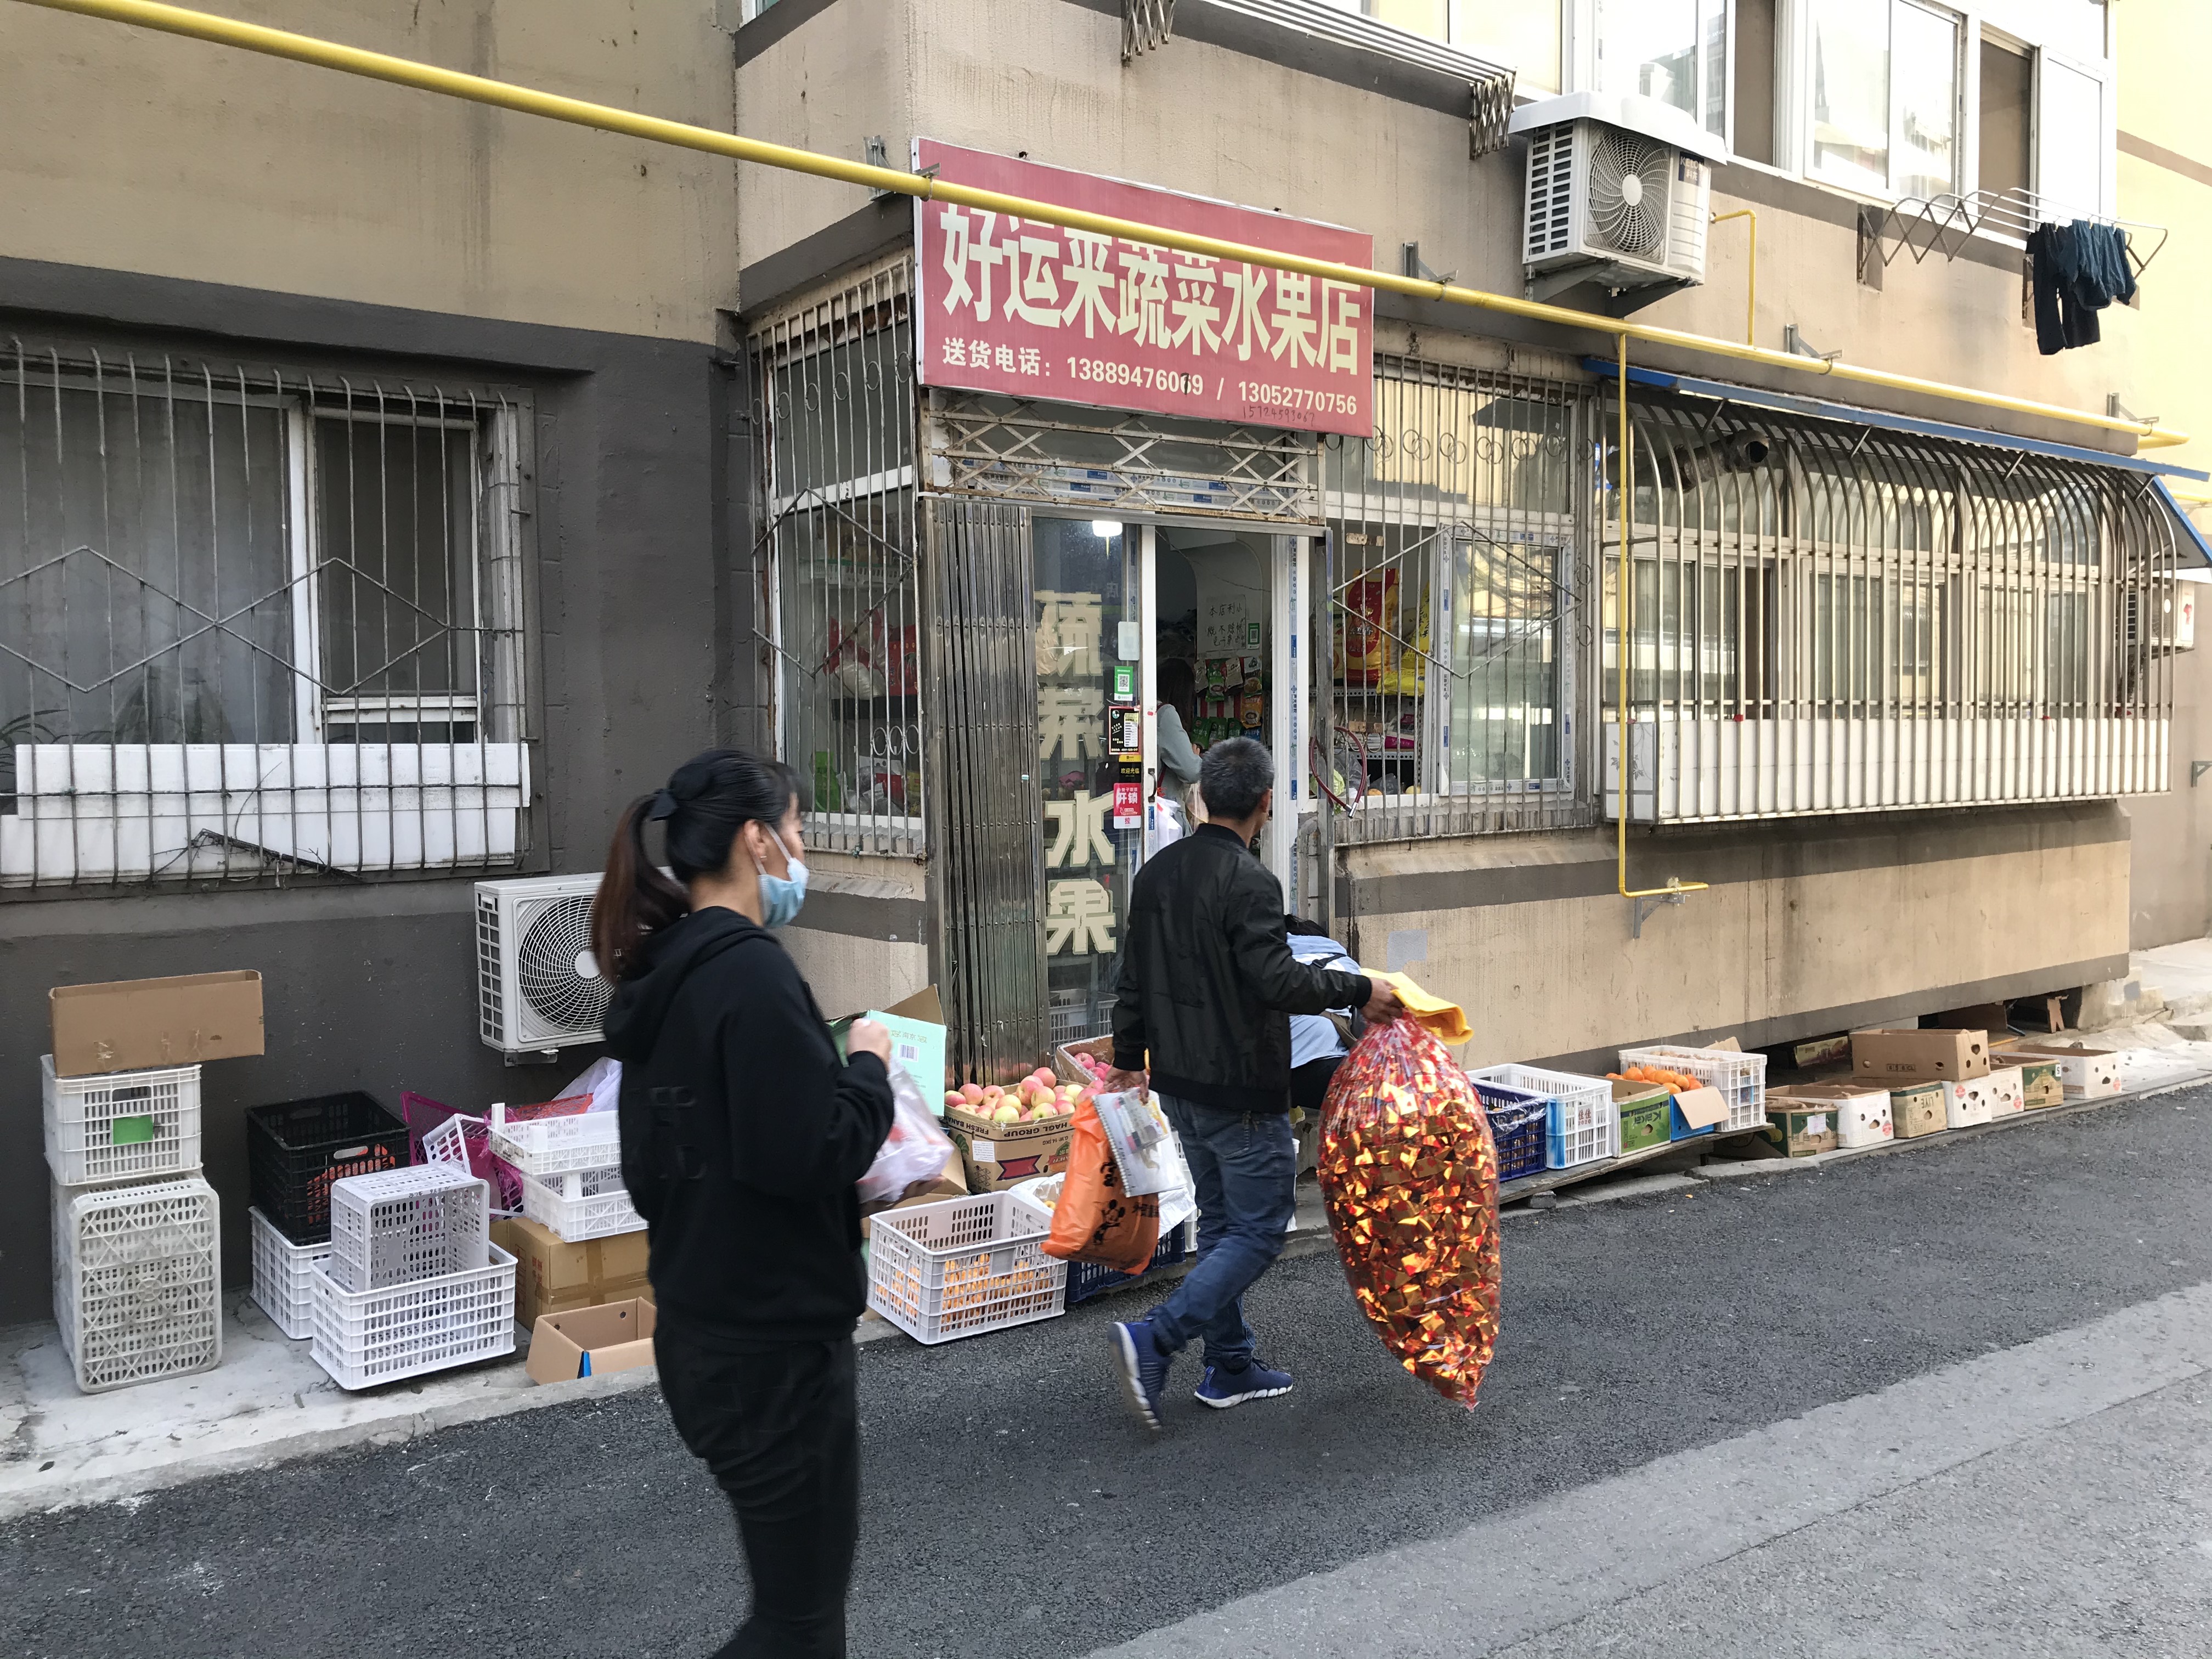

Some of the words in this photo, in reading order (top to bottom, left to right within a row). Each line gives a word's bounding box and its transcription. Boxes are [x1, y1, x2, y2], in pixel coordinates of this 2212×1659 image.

[940, 203, 1361, 376] 好运来蔬菜水果店
[1238, 381, 1357, 415] 13052770756
[1578, 1108, 1592, 1120] 佳佳
[966, 1122, 989, 1135] FRESH
[1004, 1127, 1040, 1137] GROUP
[1043, 1122, 1068, 1132] HAGL
